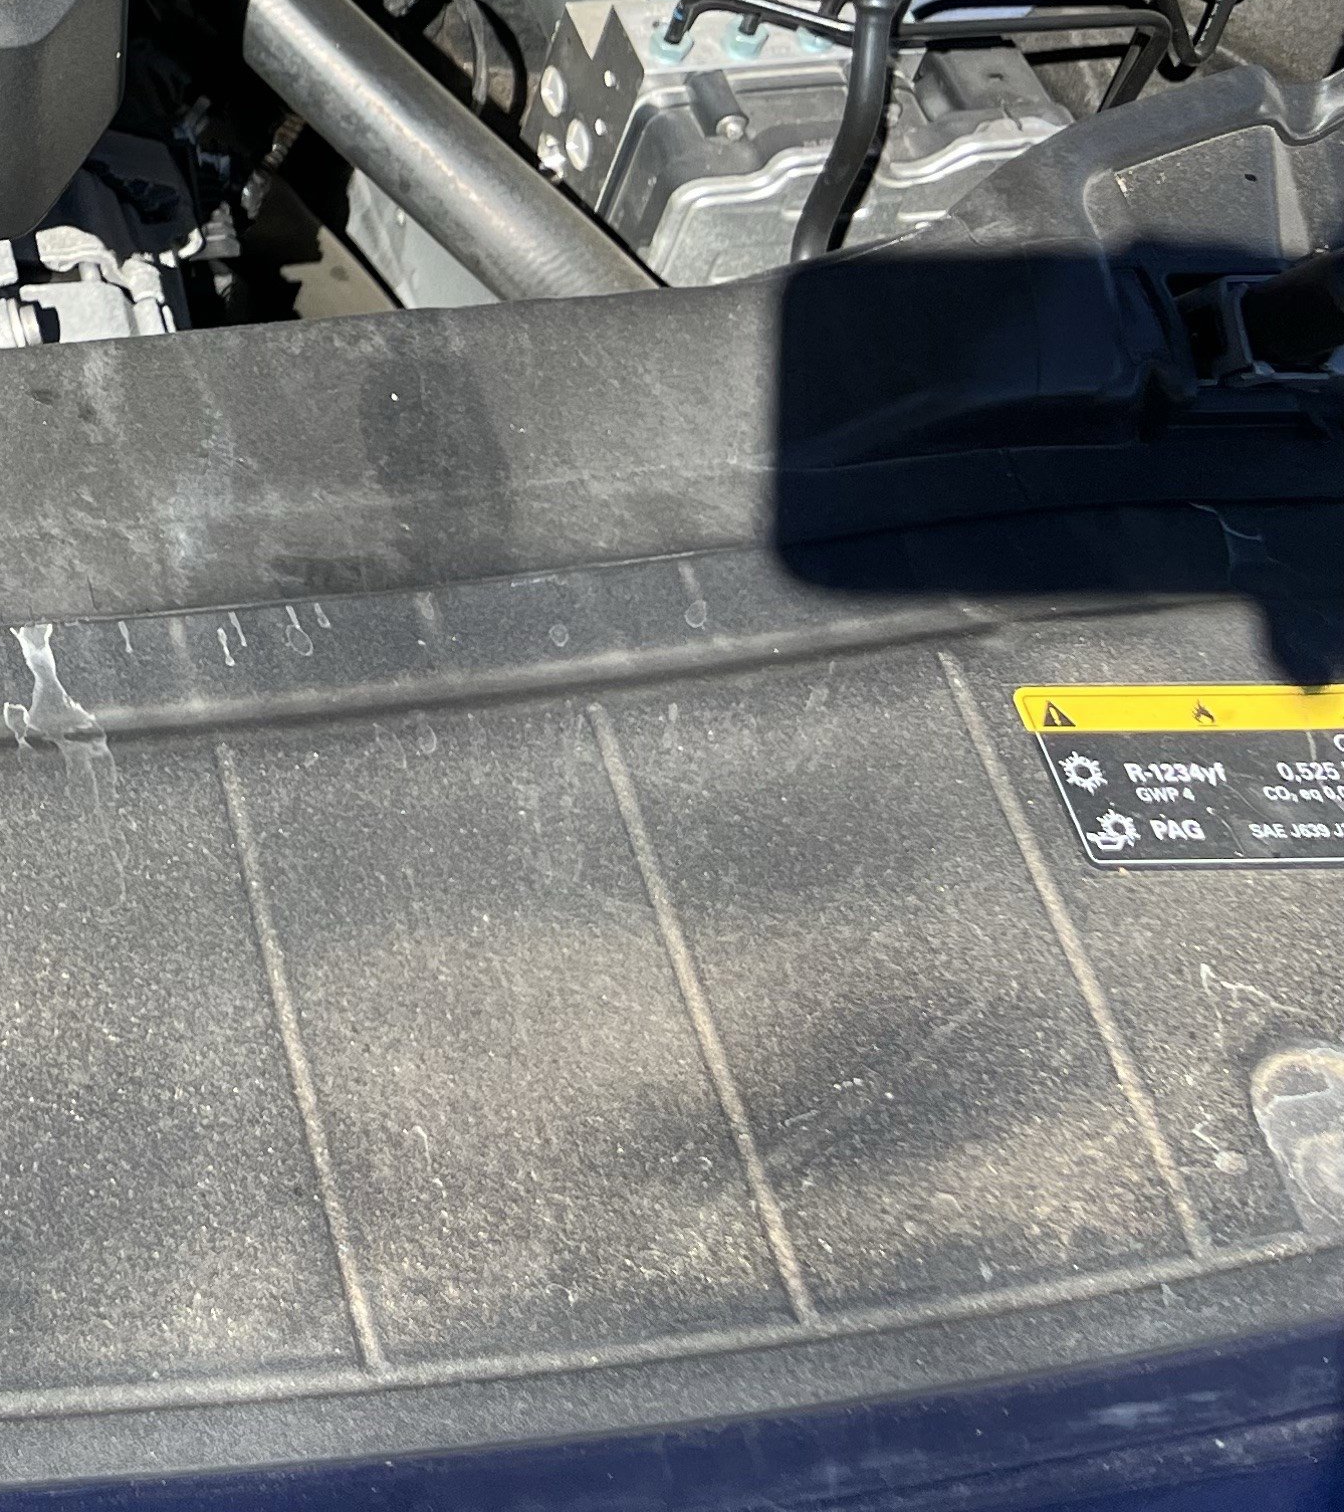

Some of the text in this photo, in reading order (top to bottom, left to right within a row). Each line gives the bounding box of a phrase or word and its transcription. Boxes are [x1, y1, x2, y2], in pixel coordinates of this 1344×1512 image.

[1123, 761, 1340, 787] R-1234yf 0,525
[1135, 785, 1196, 803] GWP 4
[1298, 788, 1325, 803] eq
[1149, 819, 1206, 841] PAG
[1248, 822, 1289, 839] SAE
[1290, 822, 1331, 839] J639
